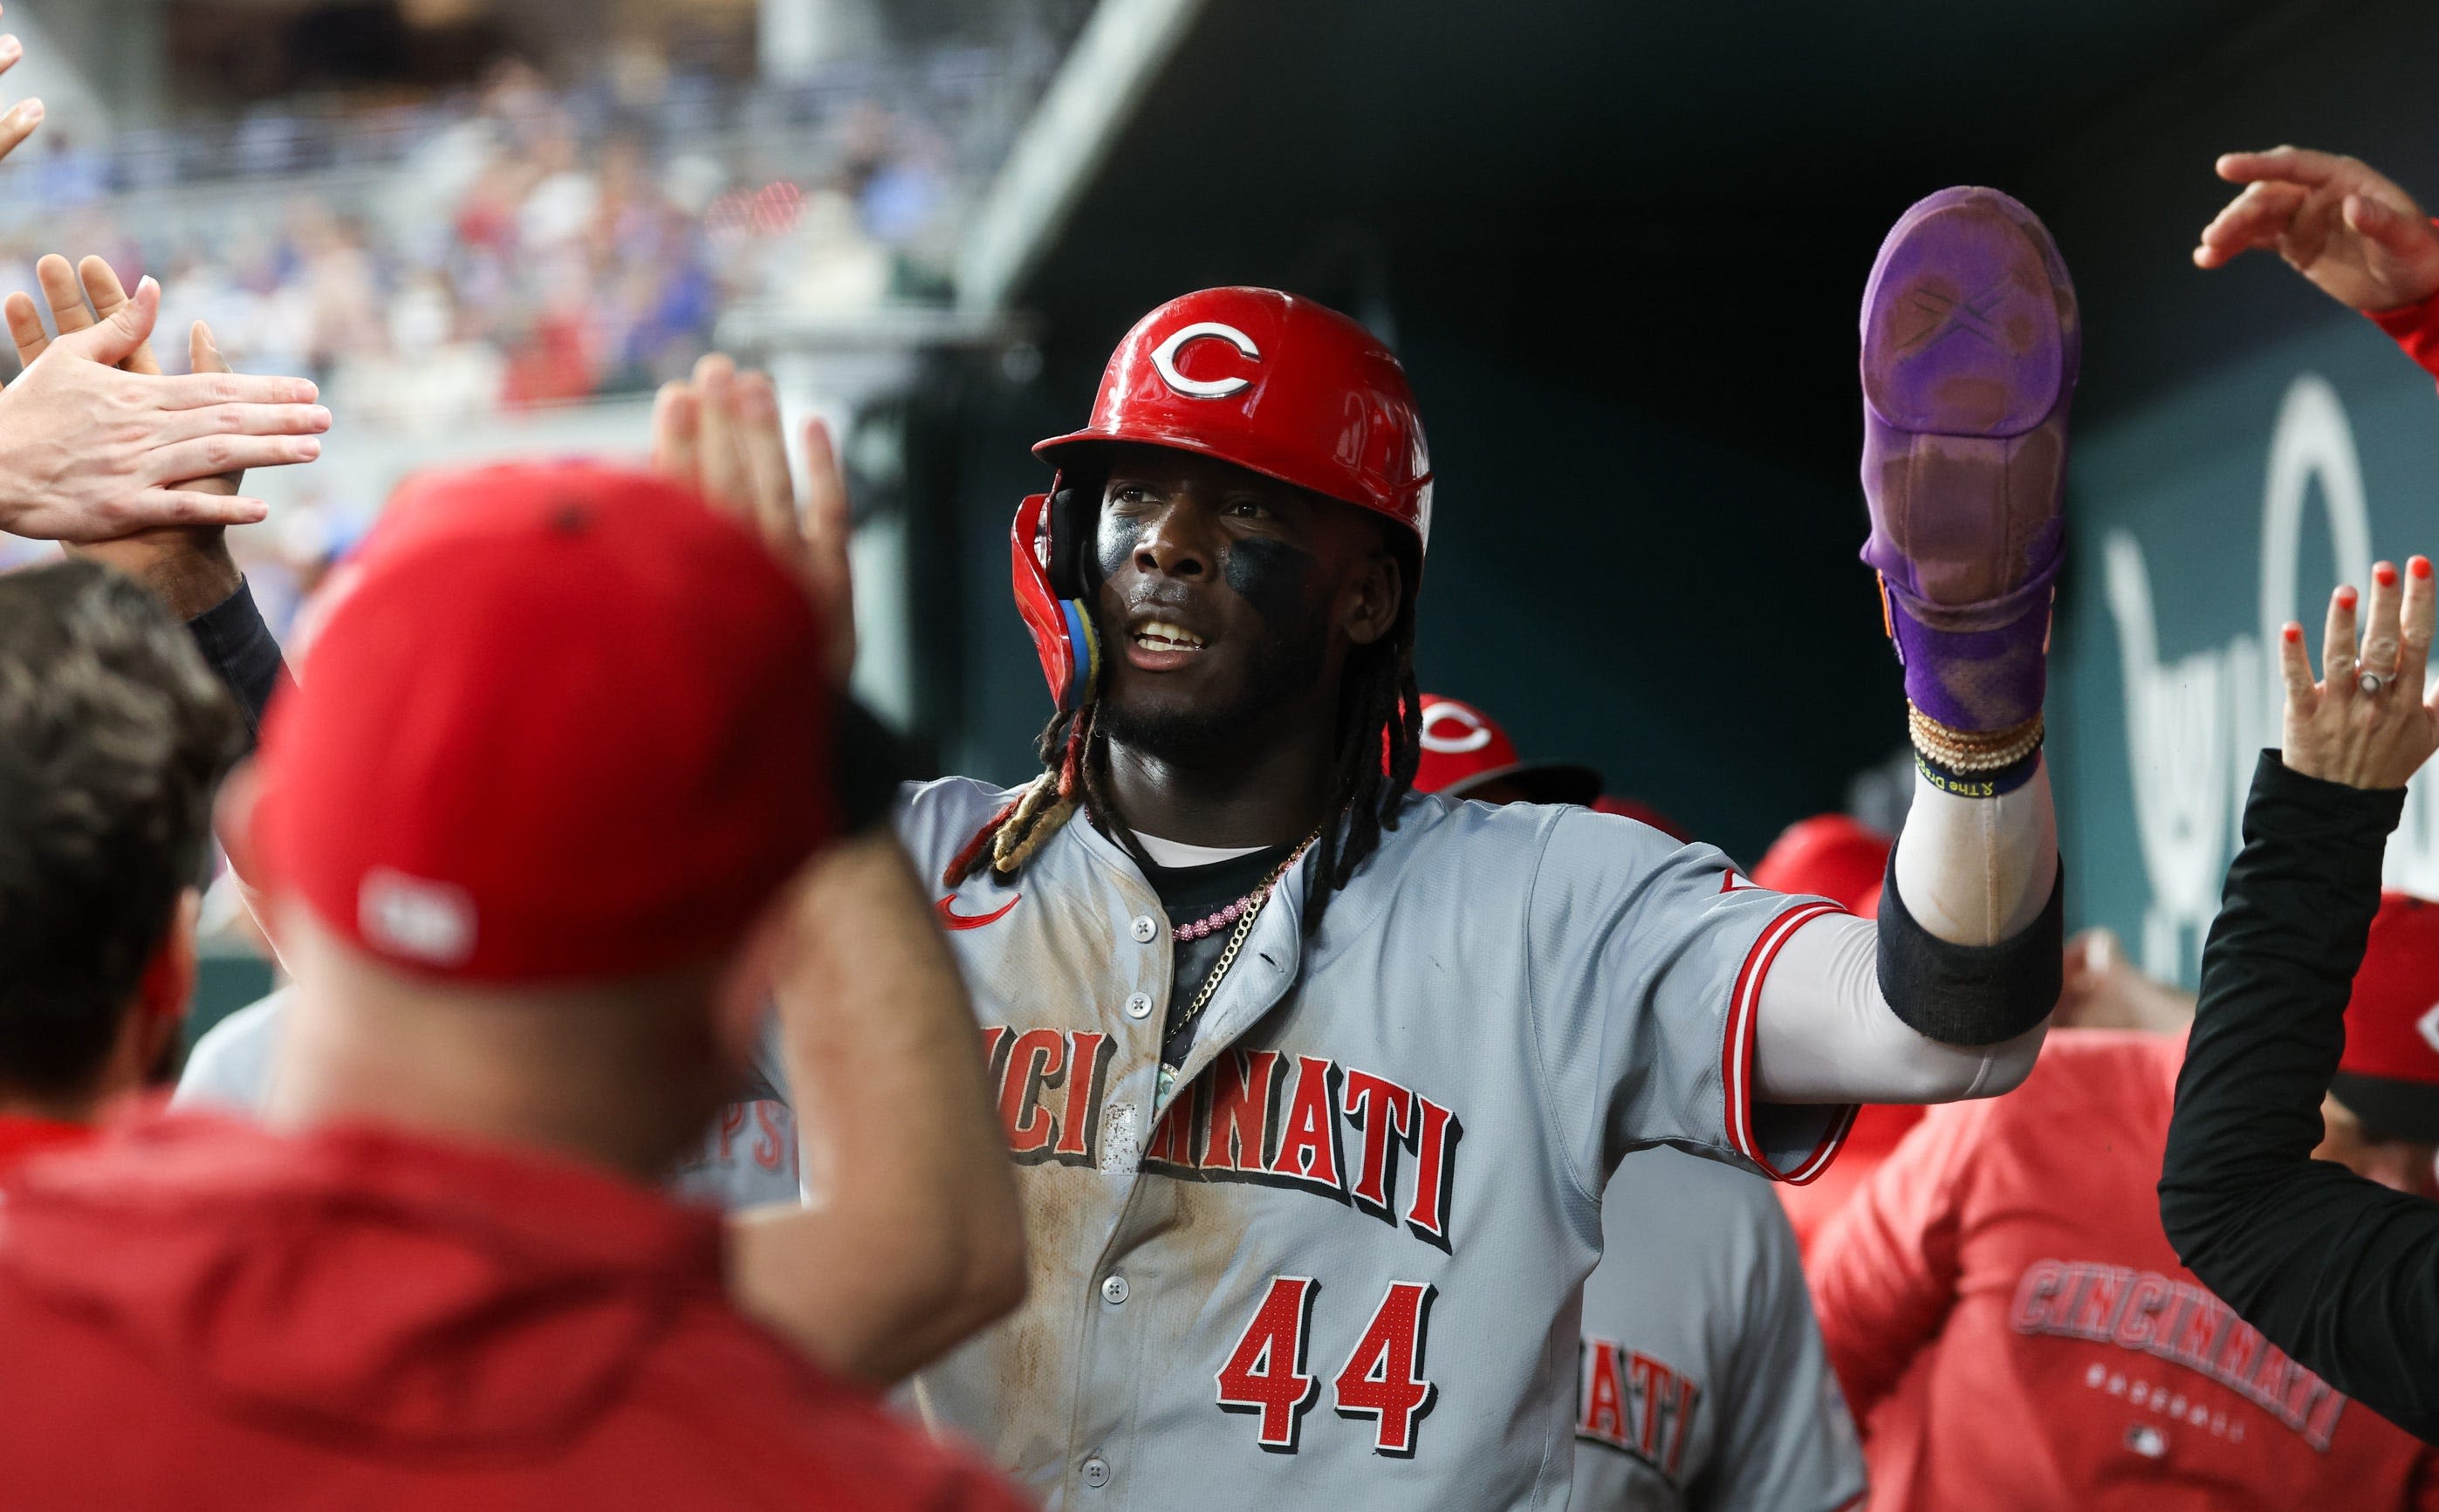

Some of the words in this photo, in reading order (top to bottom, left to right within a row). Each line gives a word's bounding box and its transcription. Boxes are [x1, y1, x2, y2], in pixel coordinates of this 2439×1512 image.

[1149, 321, 1262, 400] C
[1949, 781, 1980, 797] The
[1214, 1275, 1439, 1459] 44
